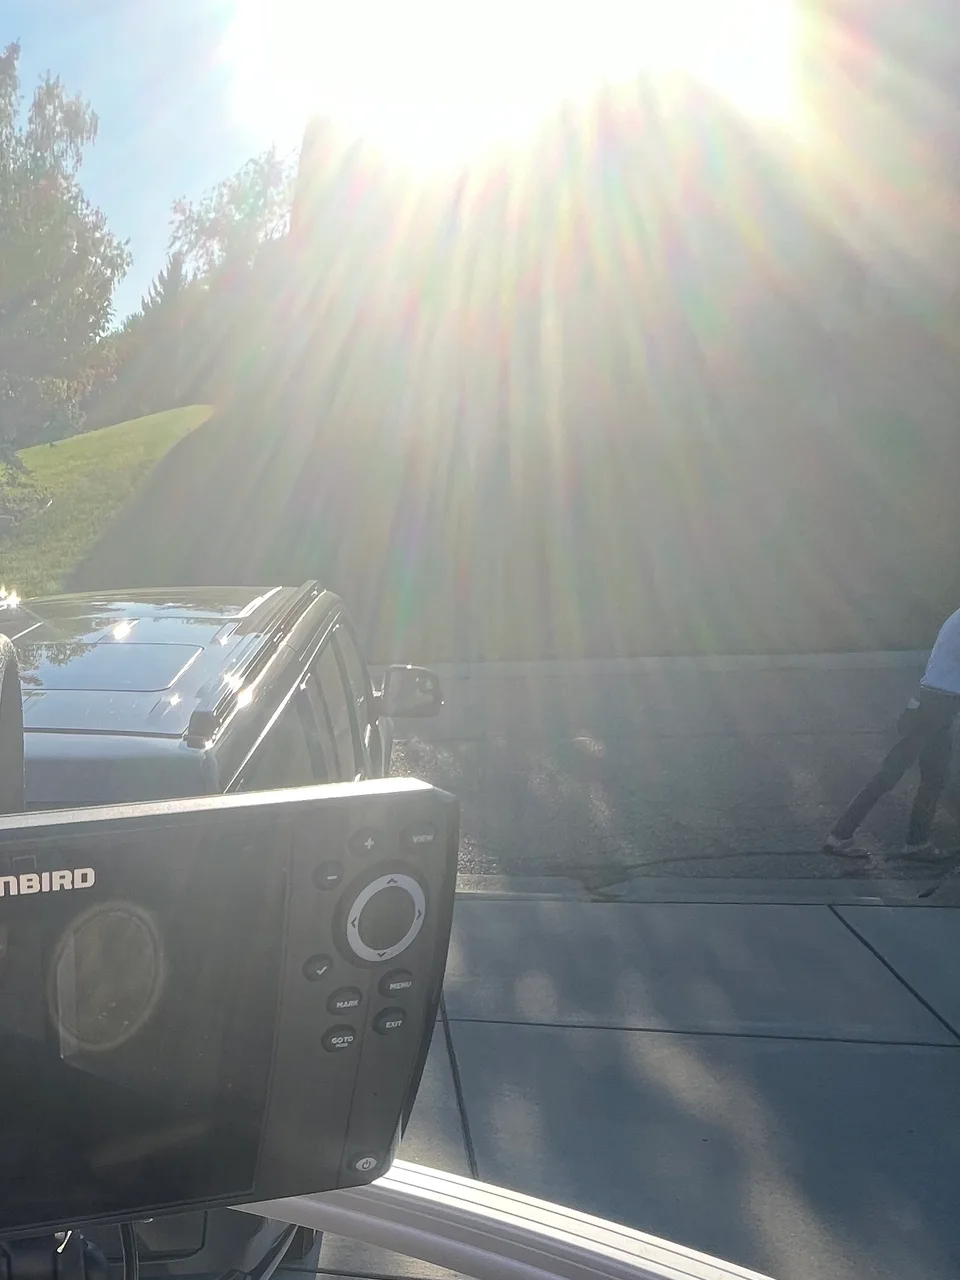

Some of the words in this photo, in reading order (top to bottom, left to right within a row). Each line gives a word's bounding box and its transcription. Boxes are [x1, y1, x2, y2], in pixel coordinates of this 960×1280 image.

[412, 834, 434, 844] VIEW
[389, 981, 413, 990] MENU
[336, 1000, 359, 1008] MARK
[385, 1020, 403, 1028] EXIT
